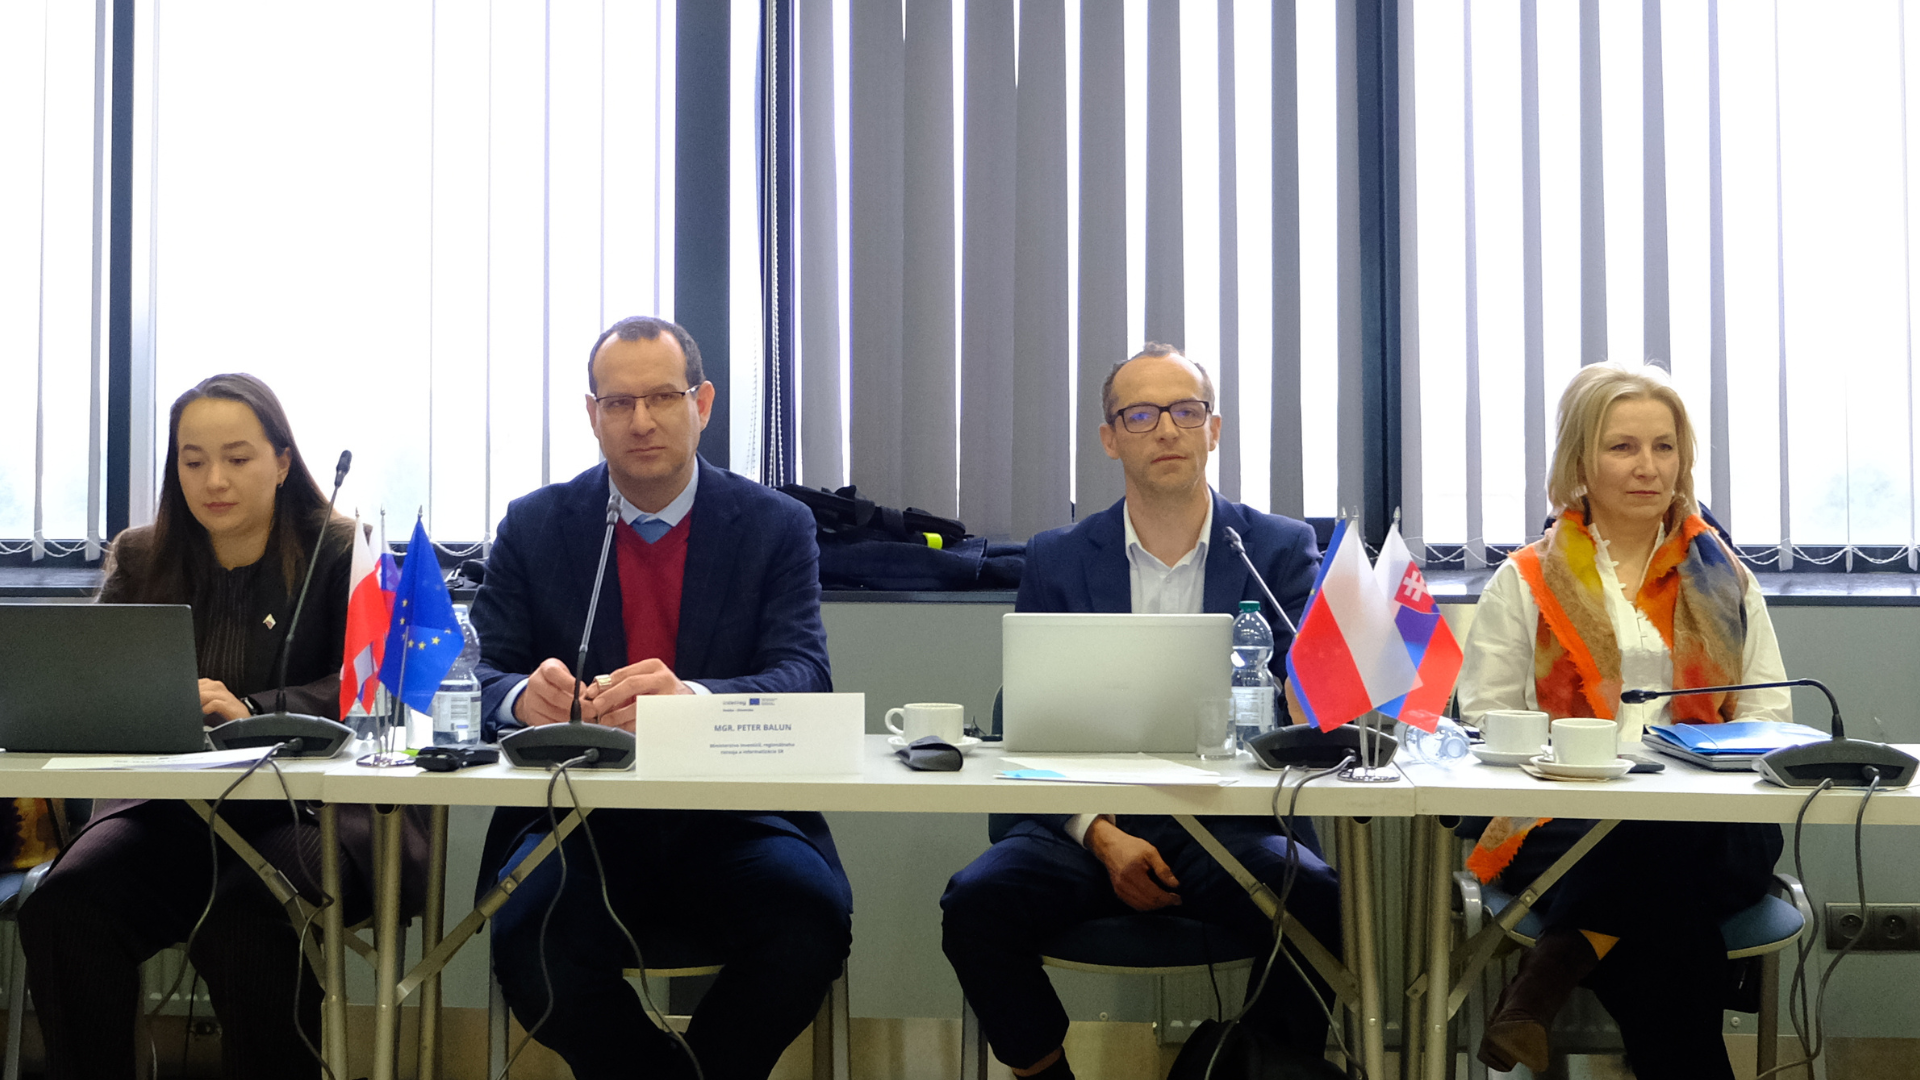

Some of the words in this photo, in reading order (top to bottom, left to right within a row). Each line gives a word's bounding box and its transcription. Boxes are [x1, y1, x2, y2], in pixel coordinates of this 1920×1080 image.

[714, 724, 735, 732] MGR.
[737, 724, 761, 732] PETER
[763, 723, 792, 731] BALUN
